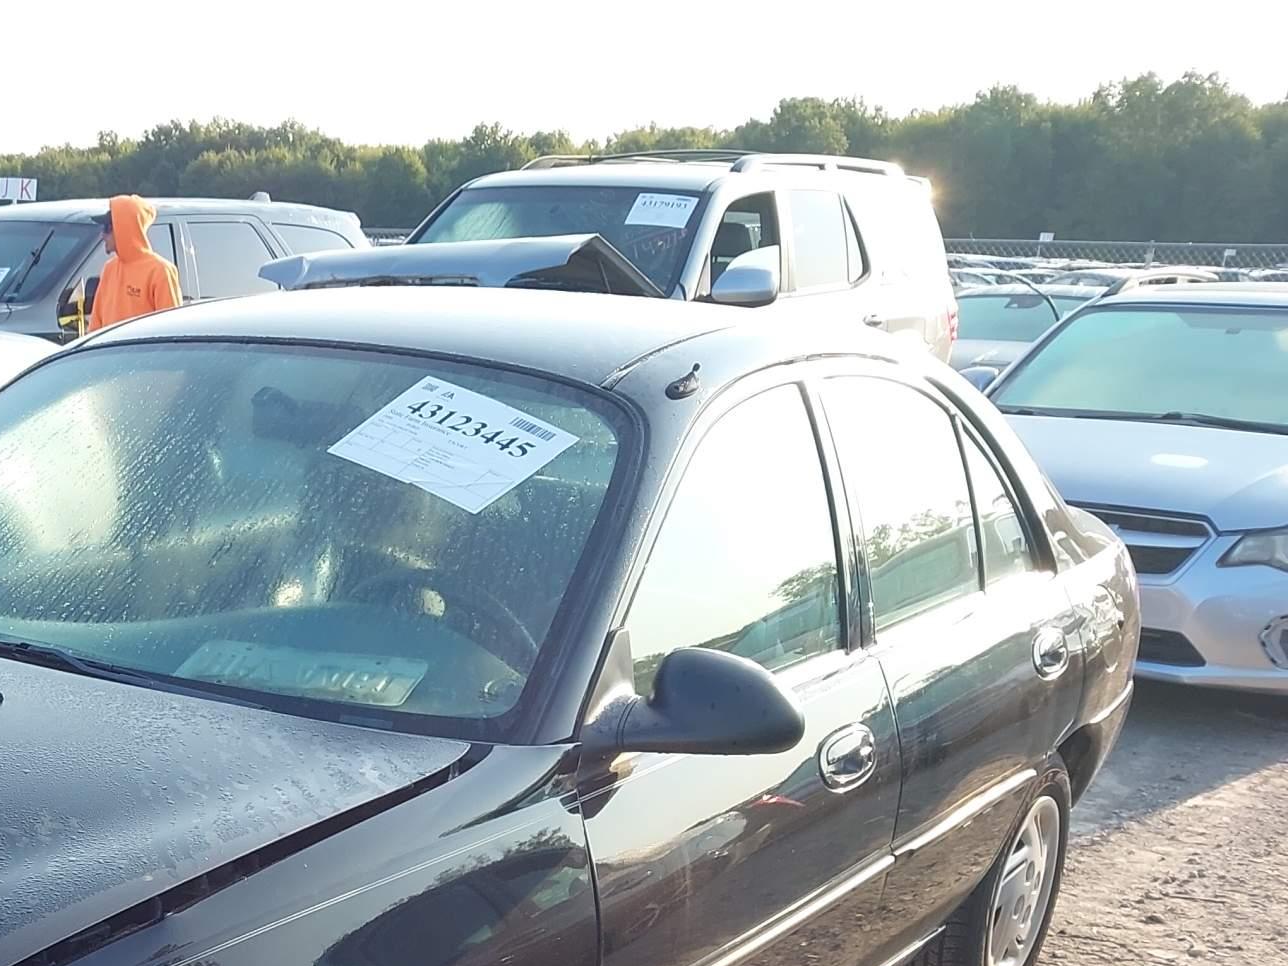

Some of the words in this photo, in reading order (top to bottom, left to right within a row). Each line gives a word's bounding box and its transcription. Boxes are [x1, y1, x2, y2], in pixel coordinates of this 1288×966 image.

[1, 177, 9, 198] J
[20, 178, 32, 200] K
[407, 400, 537, 459] 43123445
